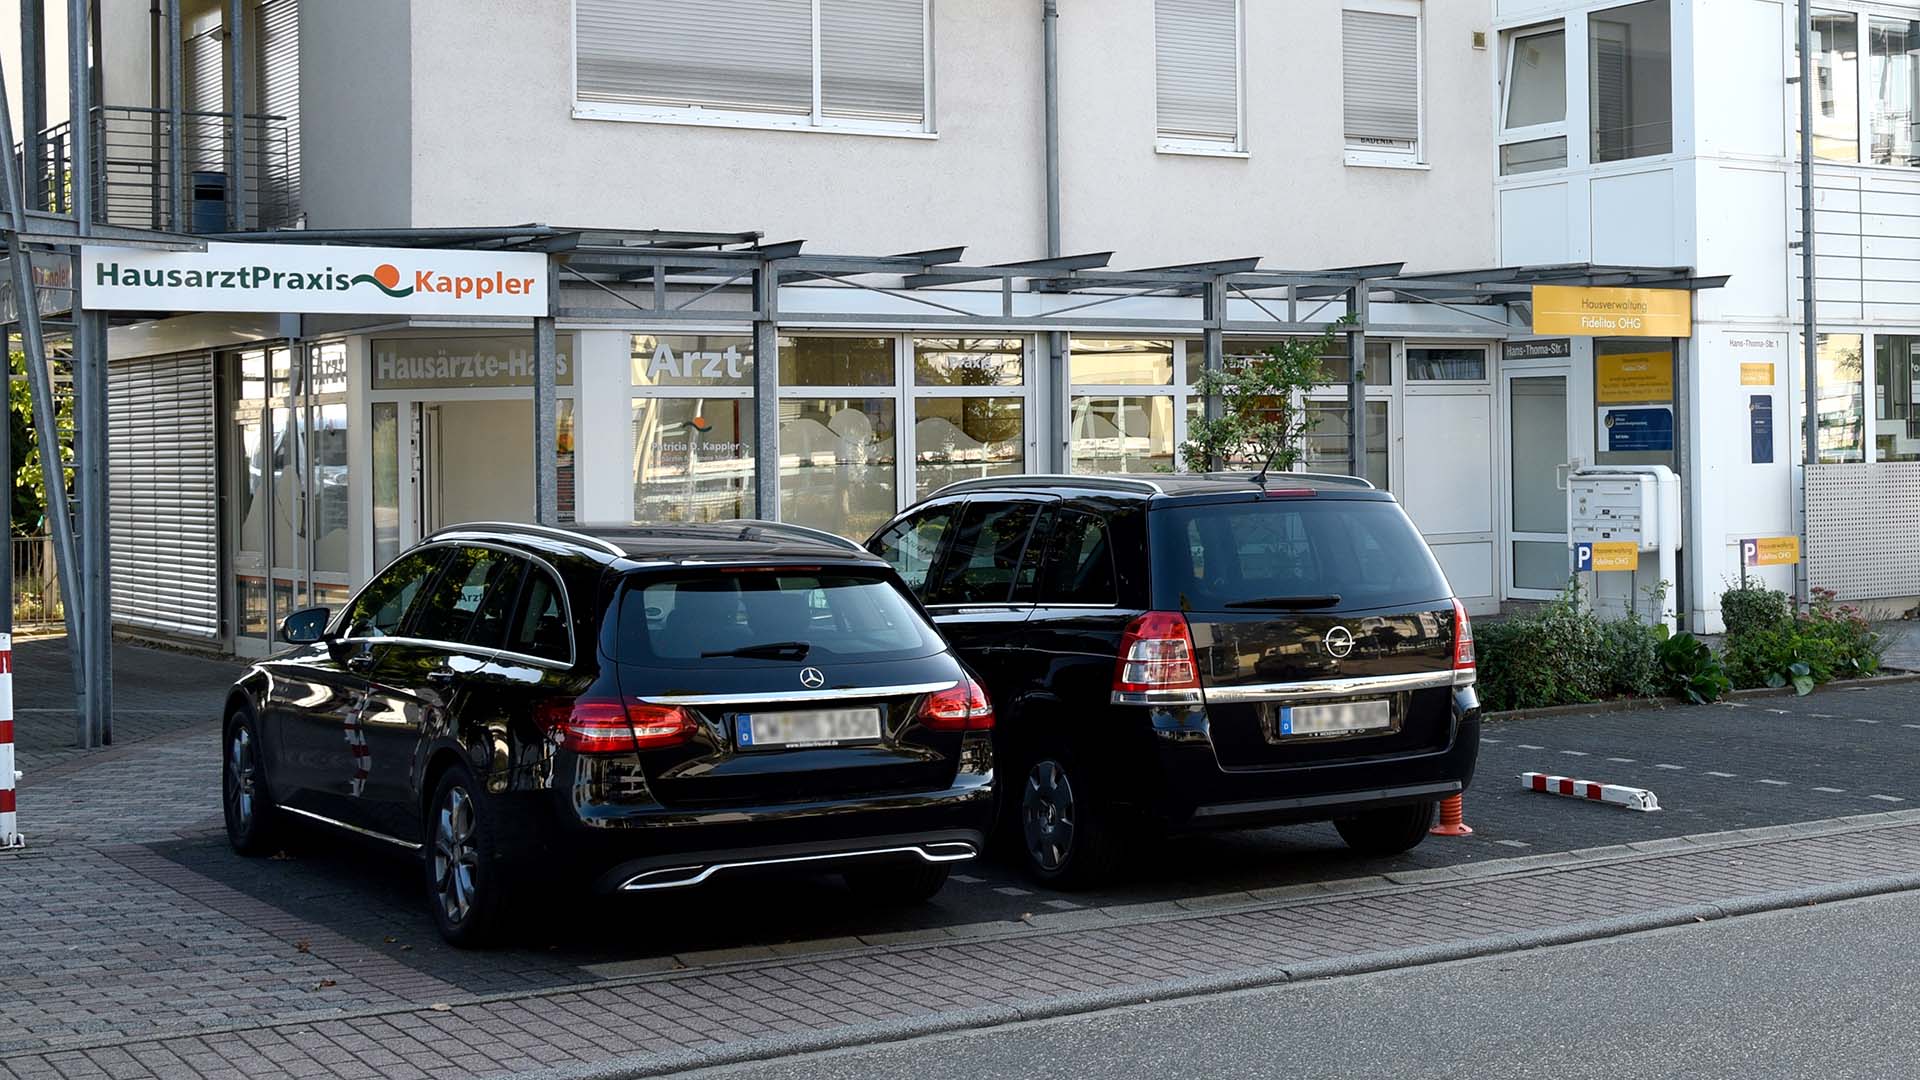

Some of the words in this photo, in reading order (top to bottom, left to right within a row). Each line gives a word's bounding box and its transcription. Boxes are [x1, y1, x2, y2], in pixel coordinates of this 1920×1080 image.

[96, 262, 351, 290] HausarztPraxis
[415, 270, 536, 299] Kappler
[1581, 298, 1648, 313] Hausverwaltung
[1581, 317, 1616, 329] Fidelitas
[1618, 317, 1642, 329] OHG
[1506, 343, 1562, 357] Hans-Thoma-Str.
[1563, 343, 1569, 353] 1
[377, 349, 568, 380] Hausärzte-Has
[646, 343, 743, 378] Arzt
[947, 355, 993, 369] Praxis
[703, 441, 740, 453] Kappler
[1578, 546, 1591, 568] P
[1744, 543, 1756, 564] P
